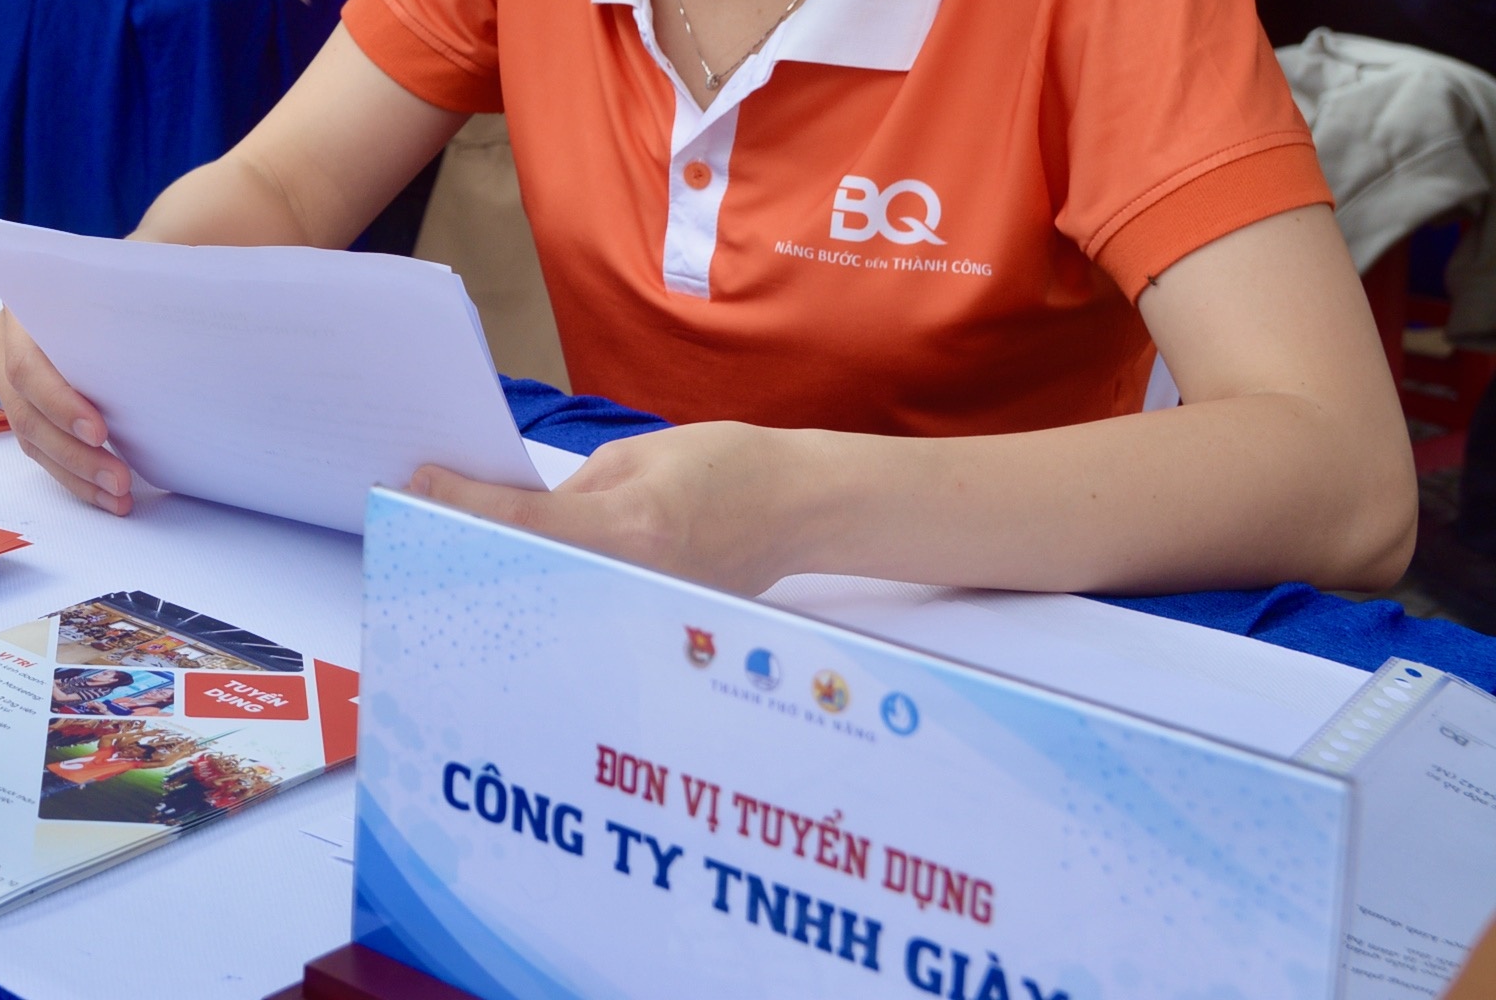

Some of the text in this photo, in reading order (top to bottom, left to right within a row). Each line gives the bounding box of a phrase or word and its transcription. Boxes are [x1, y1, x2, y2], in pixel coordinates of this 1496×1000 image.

[829, 174, 948, 246] BQ
[774, 240, 992, 276] NÂNG BƯỚC ĐẾN THÀNH CÔNG
[0, 651, 38, 668] VỊ TRÍ
[3, 664, 19, 674] kinh
[203, 688, 264, 713] DỤNG
[224, 679, 289, 707] TUYỂN
[710, 678, 878, 745] THÀNH PHỐ ĐÀ NẴNG
[596, 743, 997, 925] ĐƠN VỊ TUYỂN DỤNG
[441, 760, 1071, 1000] CÔNG TY TNHH GIÀ
